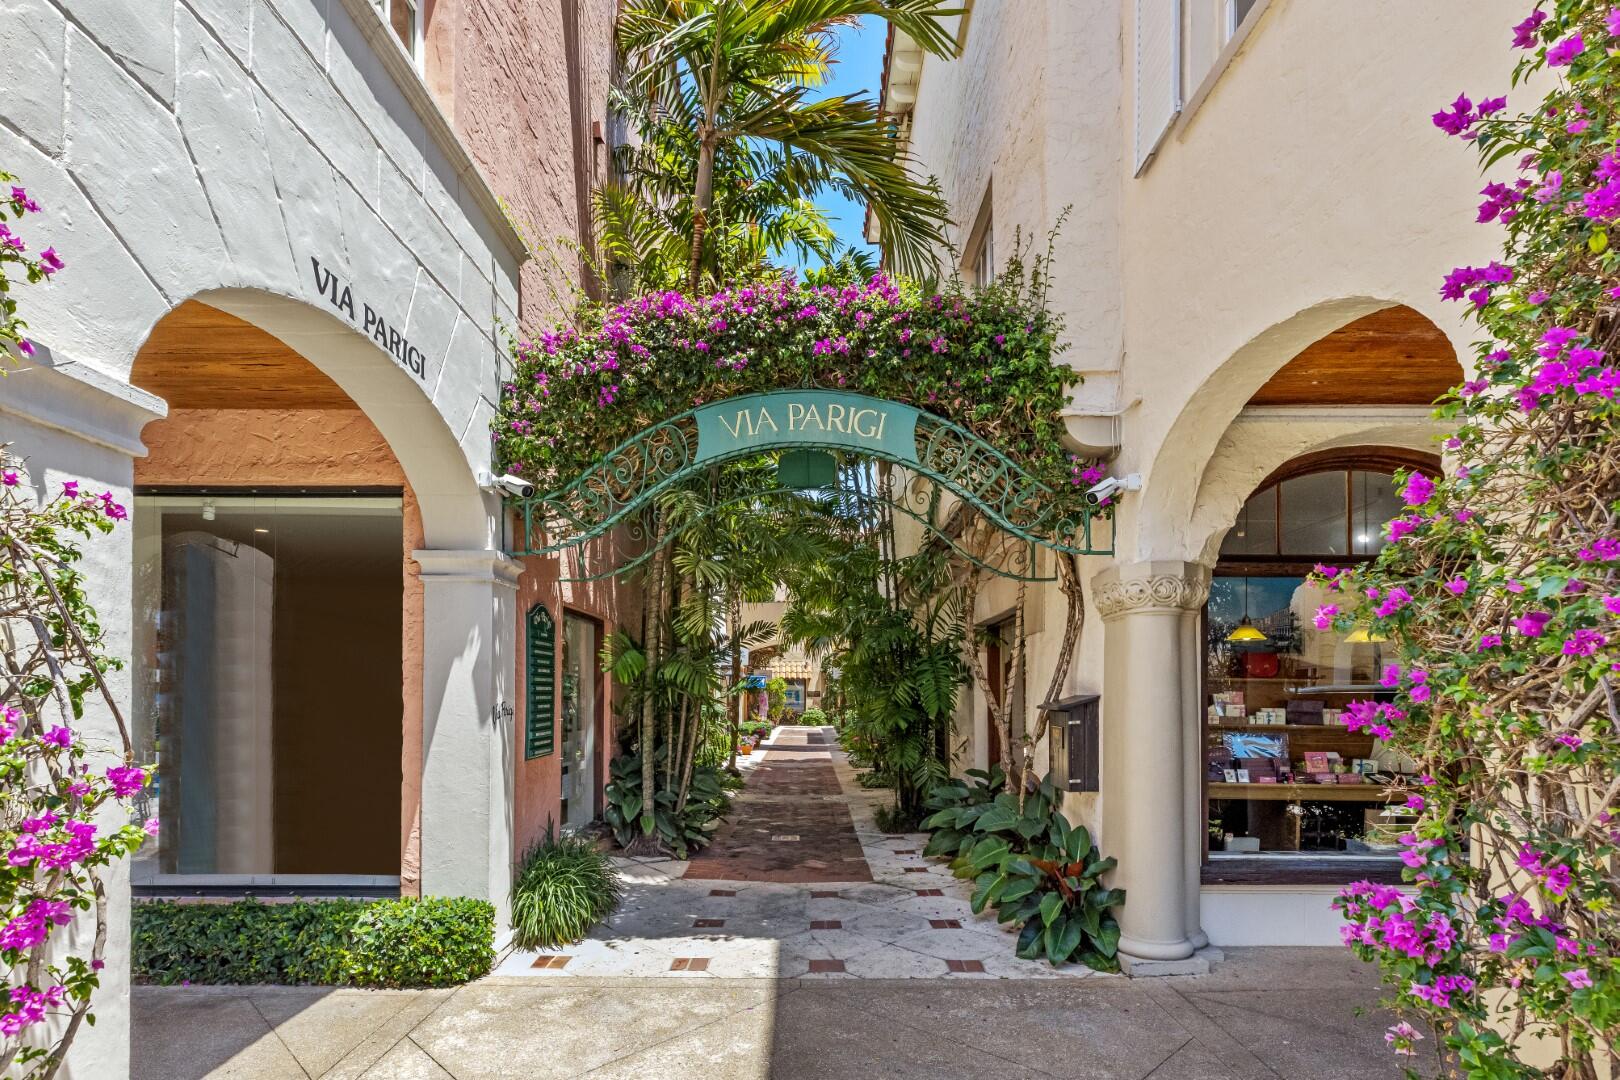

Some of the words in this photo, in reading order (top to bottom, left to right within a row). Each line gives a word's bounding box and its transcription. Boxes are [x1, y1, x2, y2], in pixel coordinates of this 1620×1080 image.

[311, 256, 355, 321] VIA
[362, 302, 426, 380] PARIGI
[718, 406, 778, 439] VIA
[788, 403, 887, 440] PARIGI
